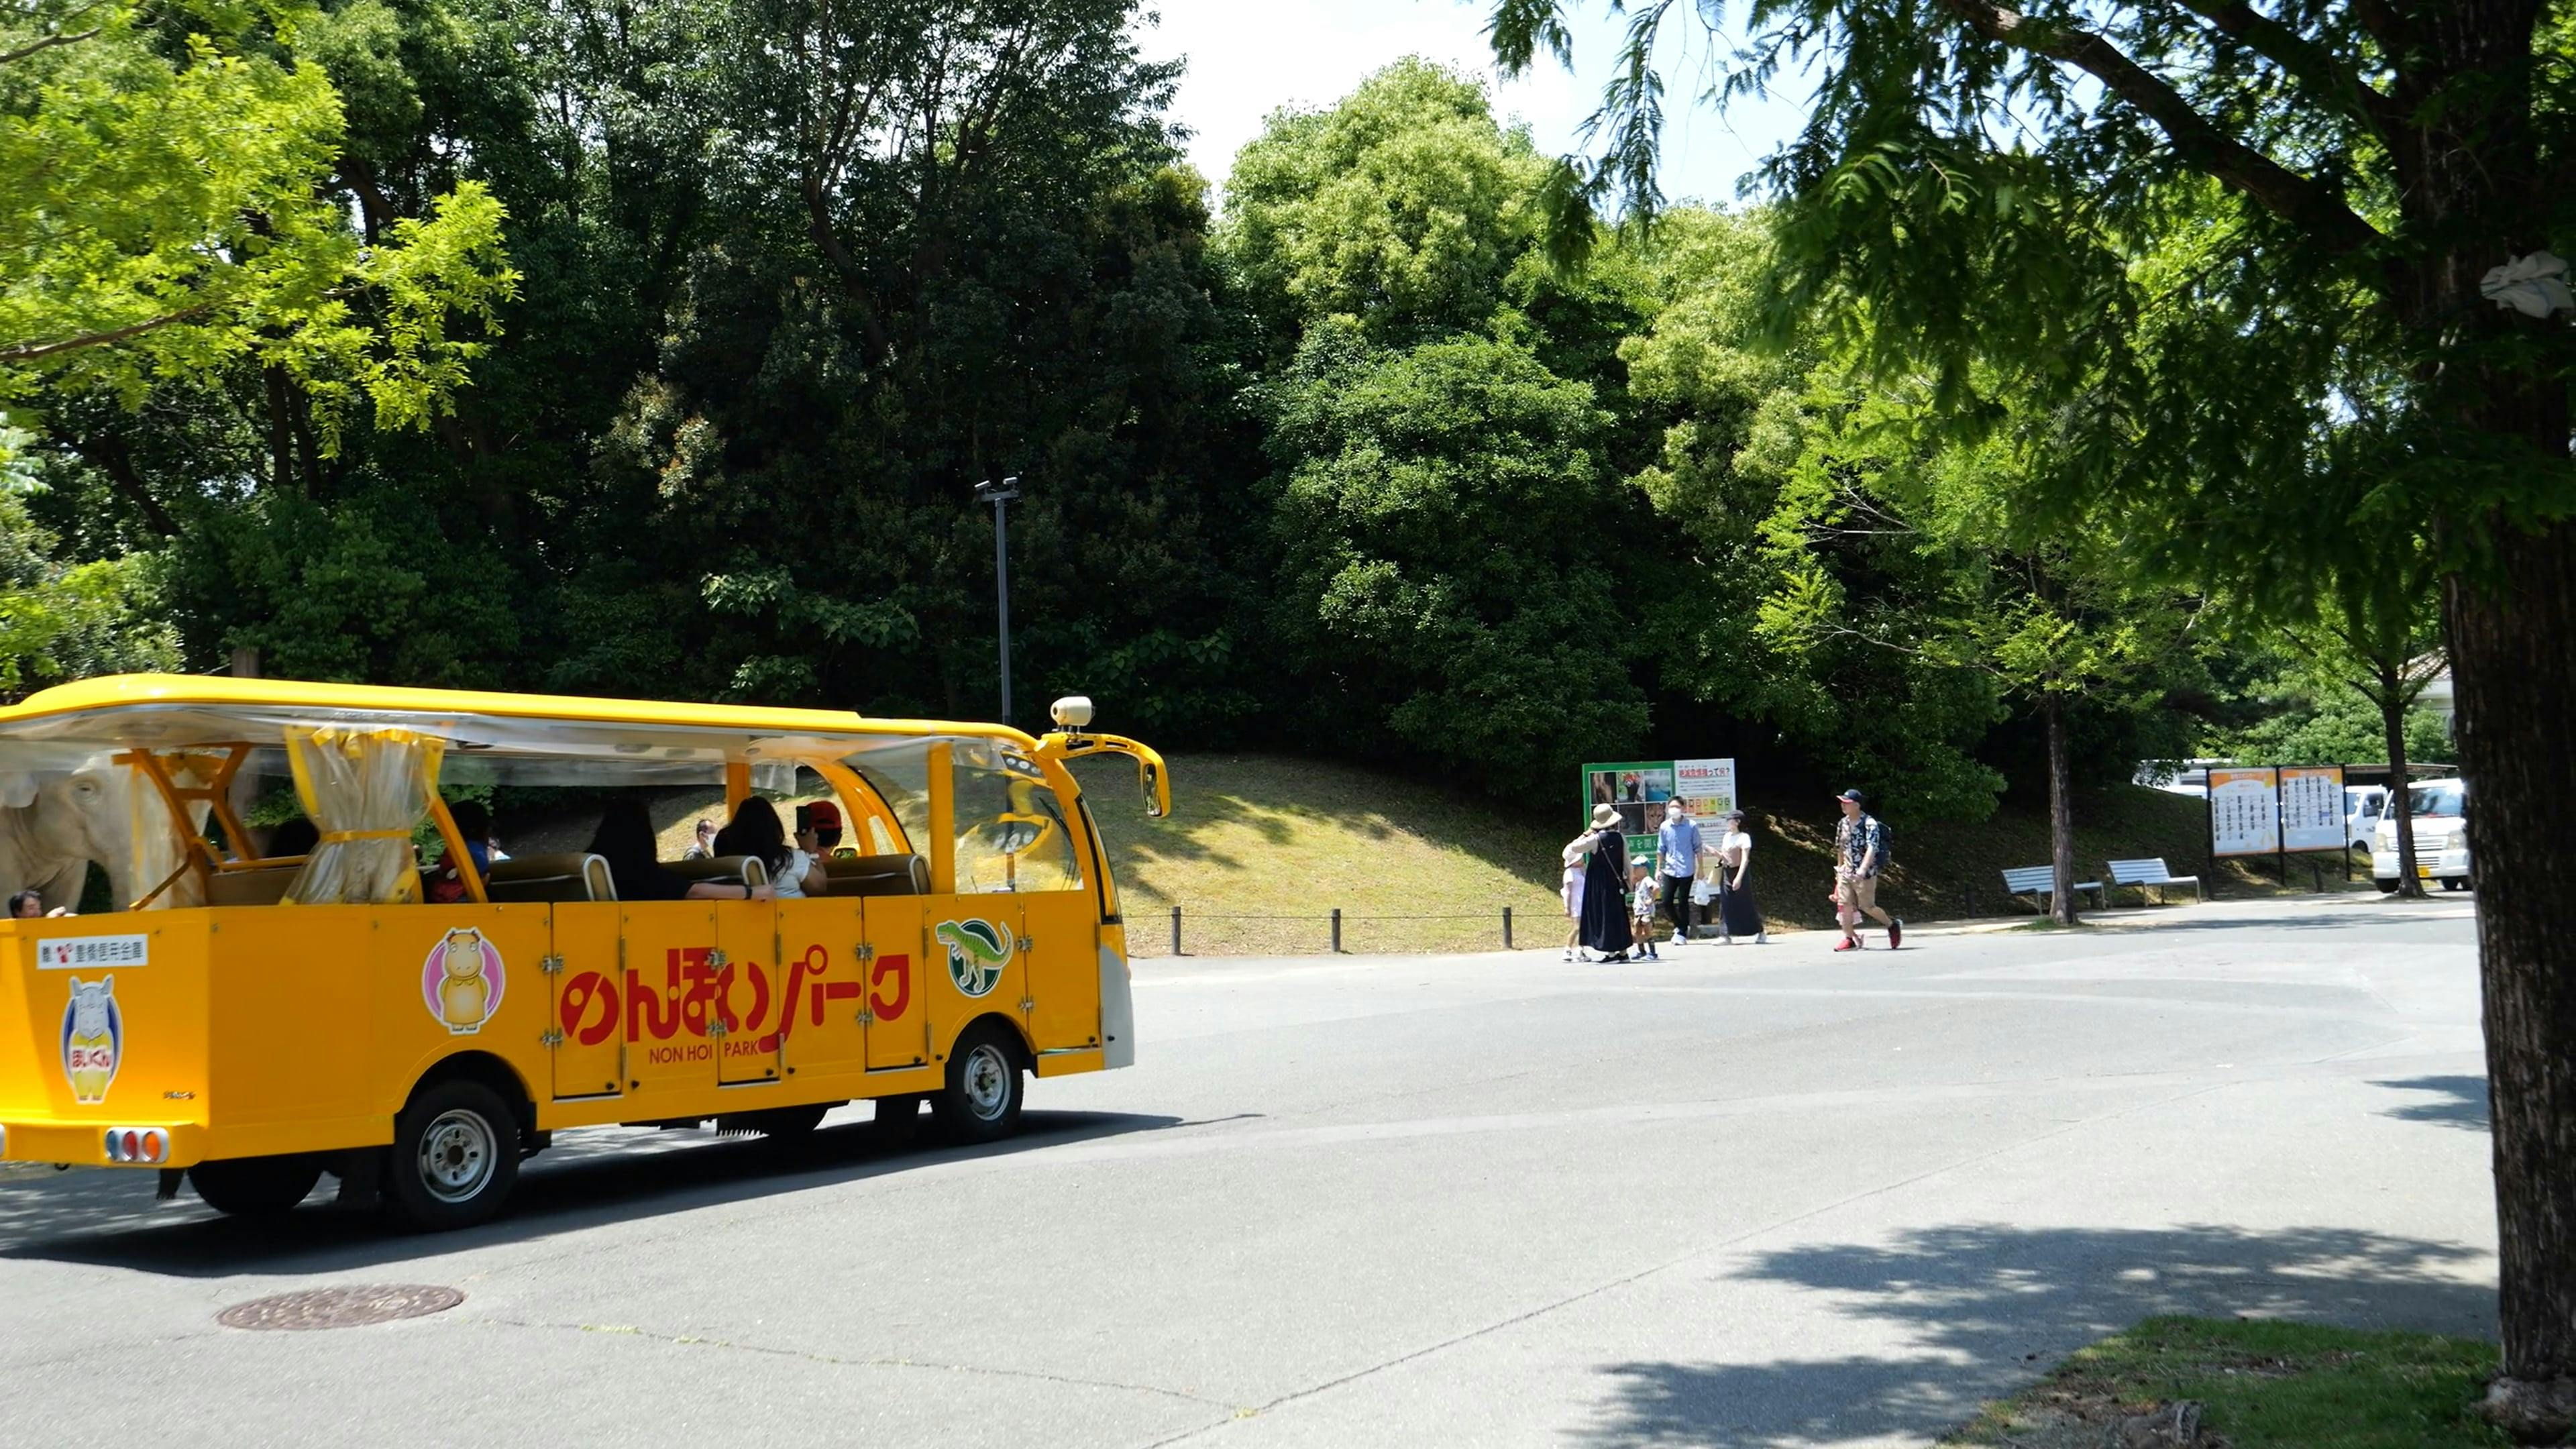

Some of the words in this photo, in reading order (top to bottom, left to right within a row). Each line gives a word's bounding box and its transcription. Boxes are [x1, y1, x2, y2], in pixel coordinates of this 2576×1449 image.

[559, 944, 910, 1054] のんほいパーク
[649, 1047, 683, 1064] NON
[688, 1044, 712, 1061] HOI
[724, 1040, 758, 1057] PARK
